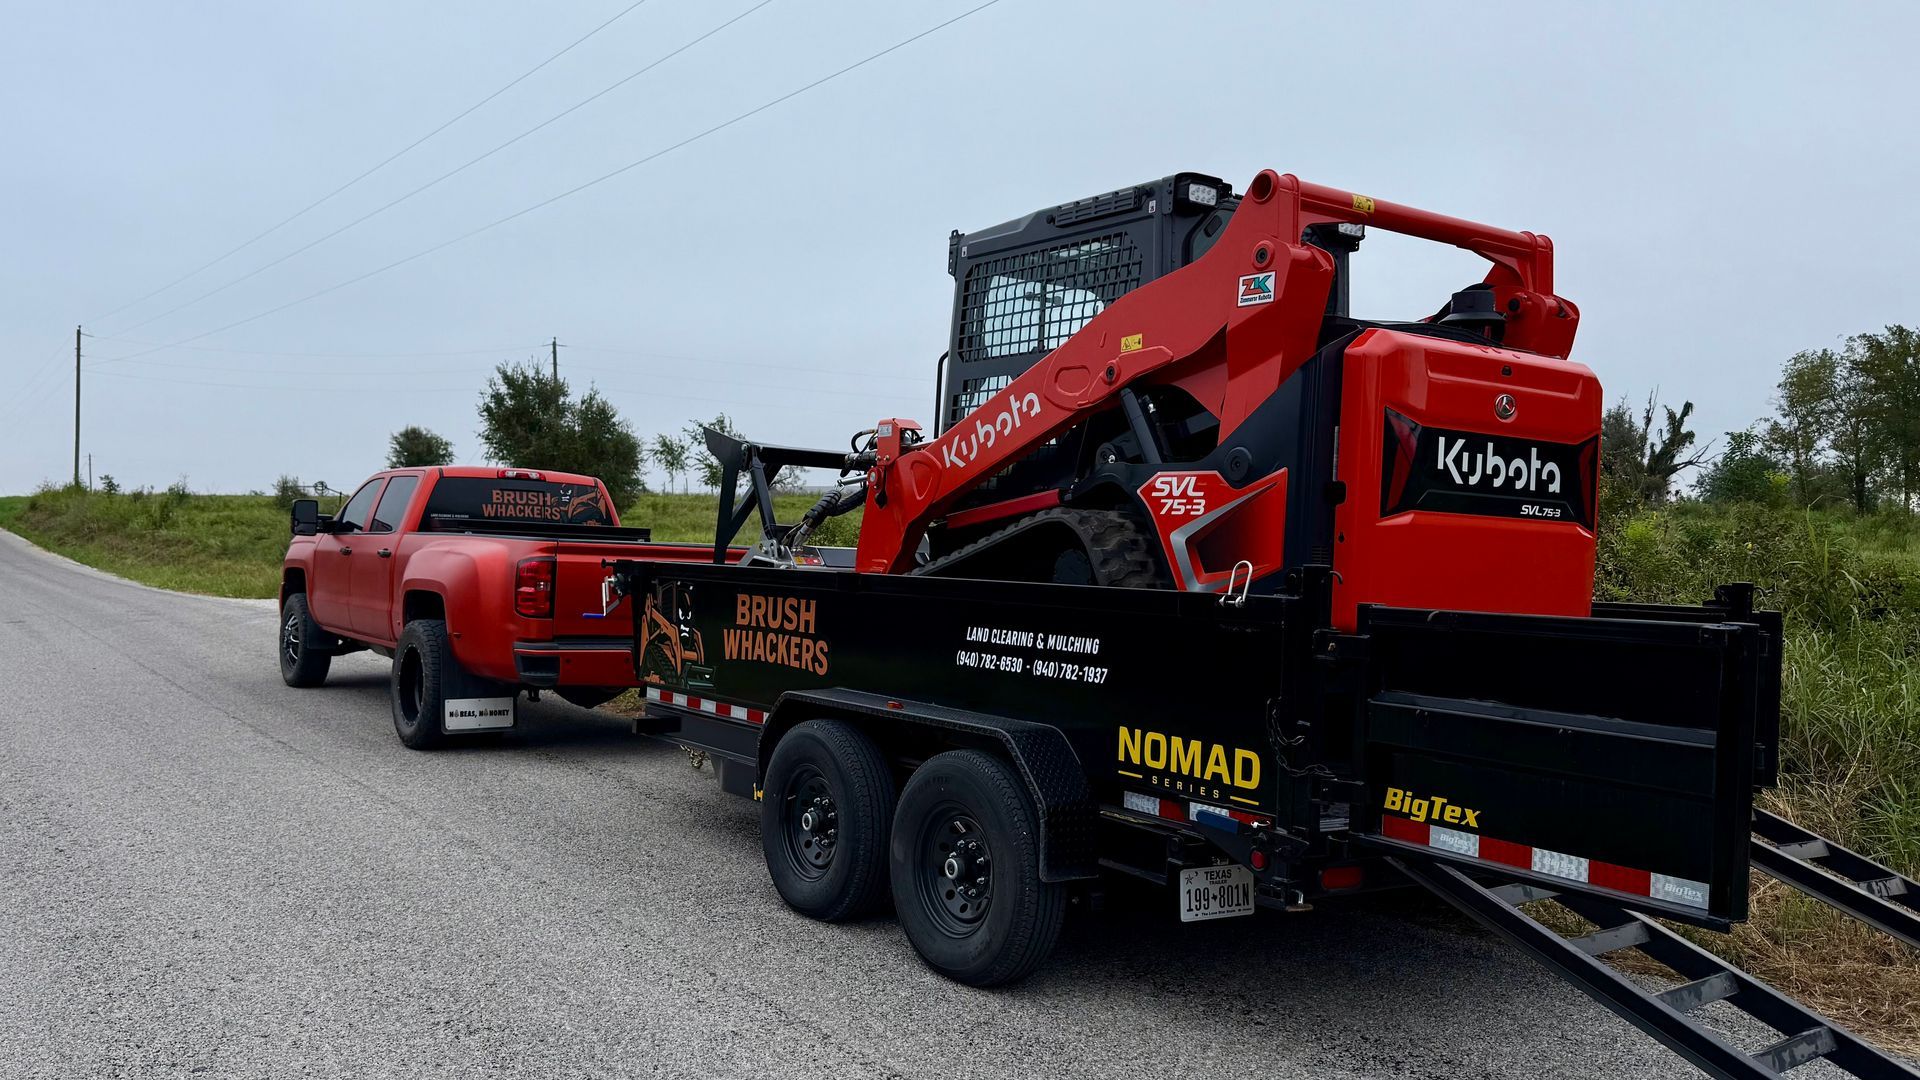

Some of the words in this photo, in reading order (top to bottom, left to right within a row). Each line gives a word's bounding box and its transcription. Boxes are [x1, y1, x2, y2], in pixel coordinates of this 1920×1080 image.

[1241, 274, 1272, 297] ZK
[942, 392, 1041, 469] Kubota
[1437, 436, 1561, 494] Kubota
[492, 489, 551, 506] BRUSH
[1151, 476, 1205, 497] SVL
[482, 503, 561, 520] WHACKERS
[1160, 498, 1206, 515] 75-3
[736, 593, 817, 634] BRUSH
[723, 628, 829, 676] WHACKERS
[966, 626, 990, 643] LAND
[991, 629, 1034, 648] CLEARING
[1036, 633, 1045, 649] &
[1047, 634, 1100, 655] MULCHING
[956, 650, 979, 668] (940)
[979, 653, 1023, 673] 782-6530
[1032, 659, 1059, 679] (940)
[1059, 663, 1109, 684] 782-1937
[1118, 725, 1261, 790] NOMAD
[1151, 775, 1220, 799] SERIES
[1383, 787, 1482, 829] BigTex
[1204, 869, 1232, 880] TEXAS
[1664, 882, 1704, 899] BigTex
